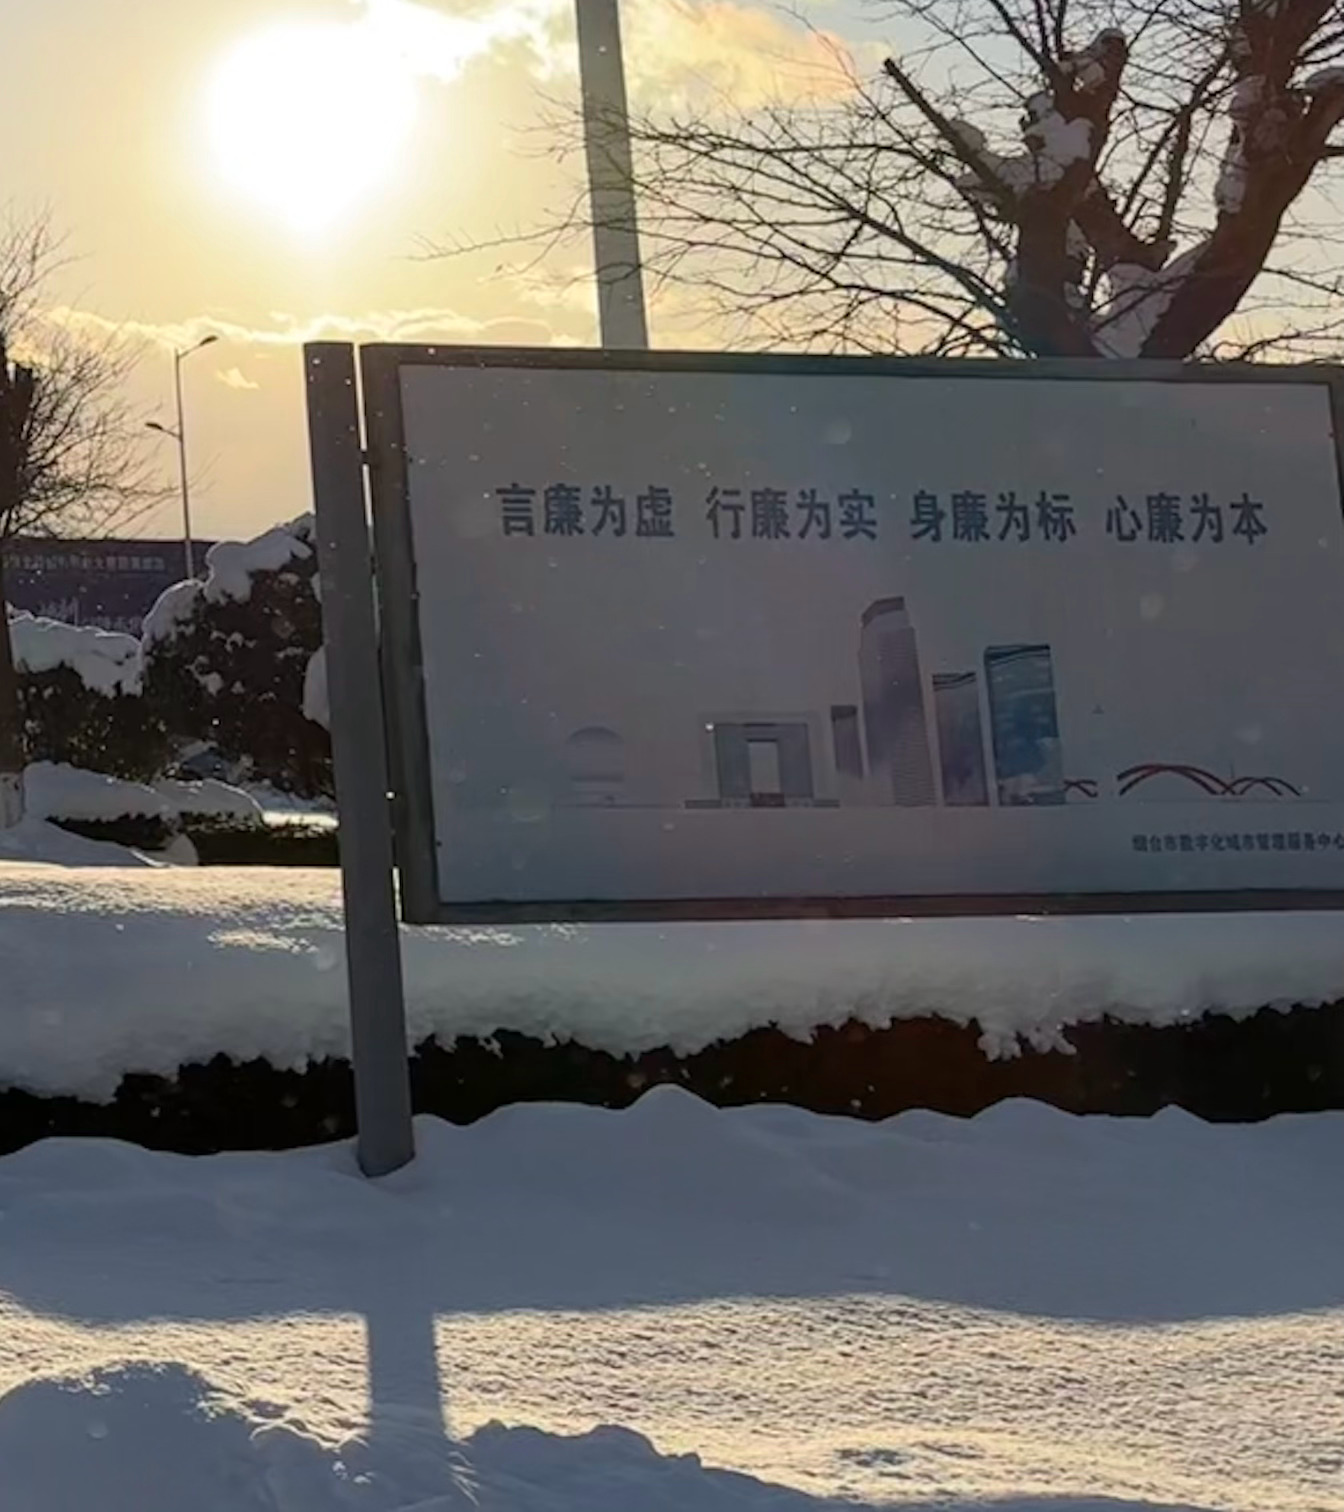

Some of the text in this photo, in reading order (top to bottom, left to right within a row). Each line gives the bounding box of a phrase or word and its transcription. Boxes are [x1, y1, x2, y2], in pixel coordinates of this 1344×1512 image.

[496, 483, 1269, 545] 言廉为虚 行廉为实 身廉为标 心廉为本
